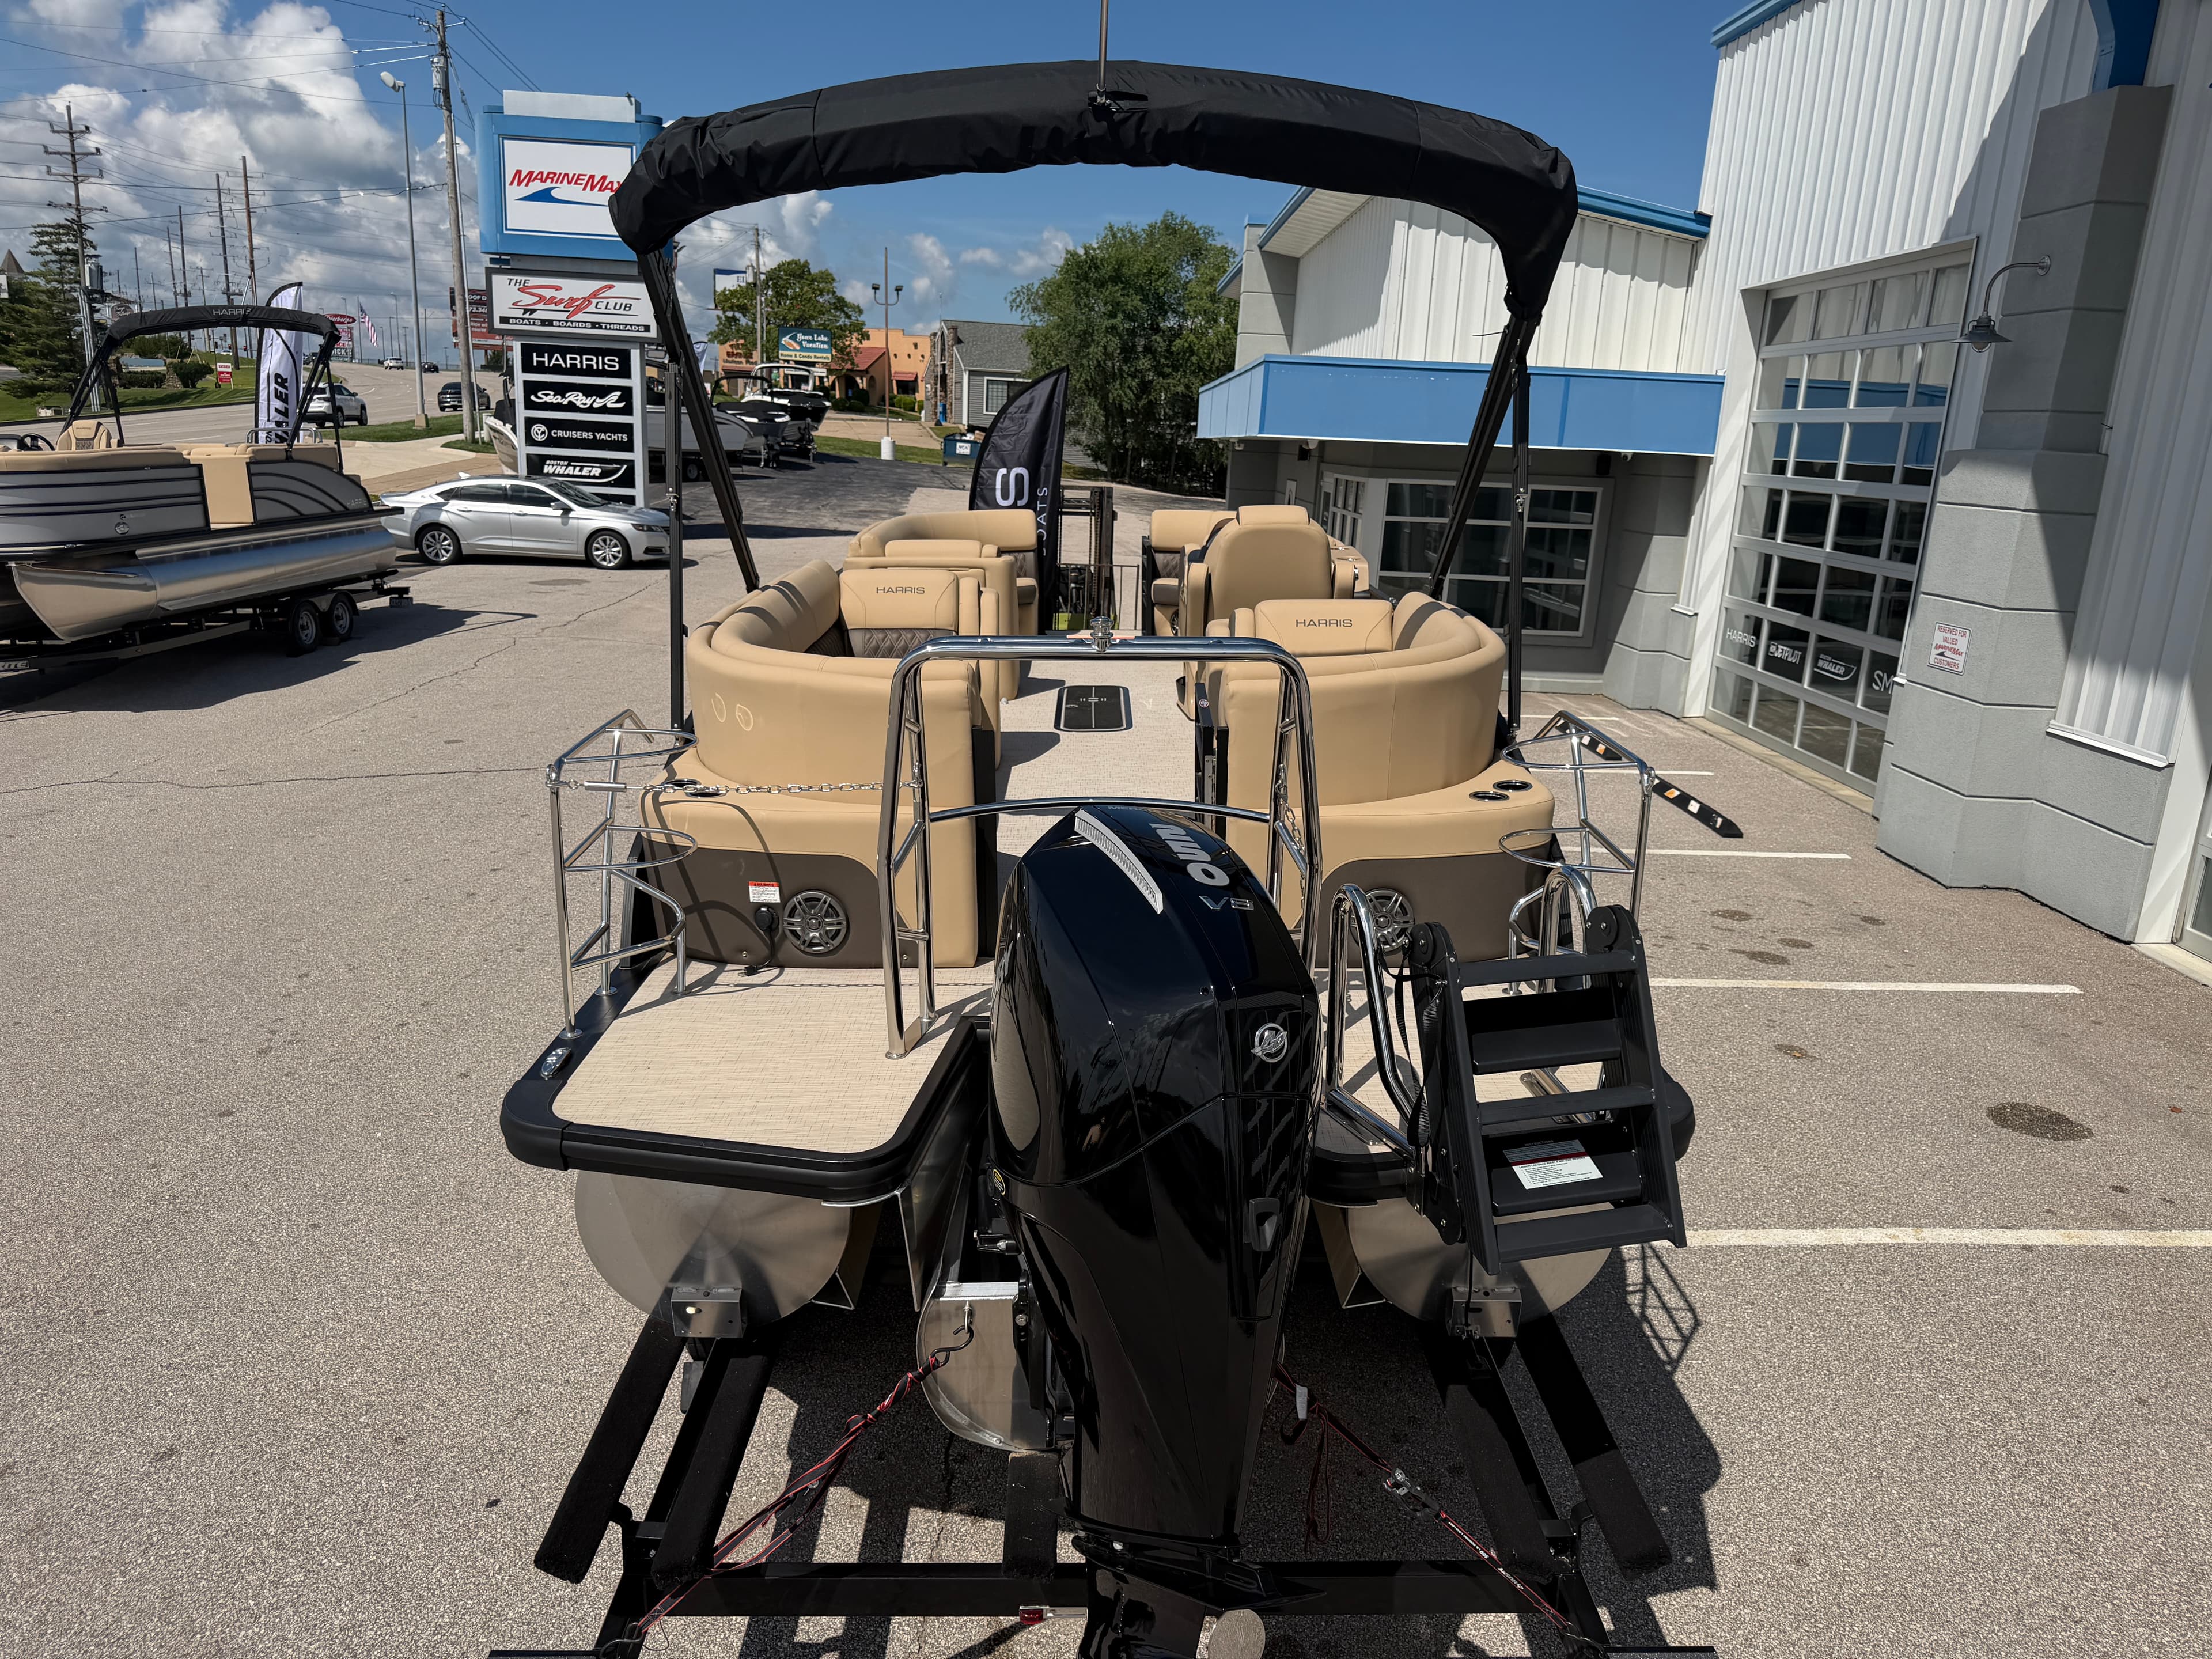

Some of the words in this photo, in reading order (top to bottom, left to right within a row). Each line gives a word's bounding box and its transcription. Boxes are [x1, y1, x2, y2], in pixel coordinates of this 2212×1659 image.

[507, 278, 531, 287] THE
[512, 284, 641, 319] Surf
[594, 301, 633, 312] CLUB
[601, 324, 645, 332] THREADS
[796, 332, 813, 342] Your
[814, 334, 829, 342] Lake
[802, 340, 829, 349] Vacation
[533, 352, 619, 370] HARRIS
[274, 373, 290, 444] HALER
[551, 430, 593, 440] CRUISERS
[595, 432, 628, 442] YACHTS
[543, 465, 602, 476] WHALER
[876, 586, 925, 594] HARRIS
[1296, 619, 1353, 627] HARRIS
[1937, 625, 1958, 636] RESERVED
[1958, 629, 1967, 638] FOR
[1726, 628, 1756, 648] HARRIS
[1943, 636, 1959, 645] VALUED
[1774, 644, 1802, 664] JETPILOT
[1817, 658, 1846, 676] WHALER
[1934, 657, 1960, 669] CUSTOMERS
[1199, 895, 1255, 911] V8
